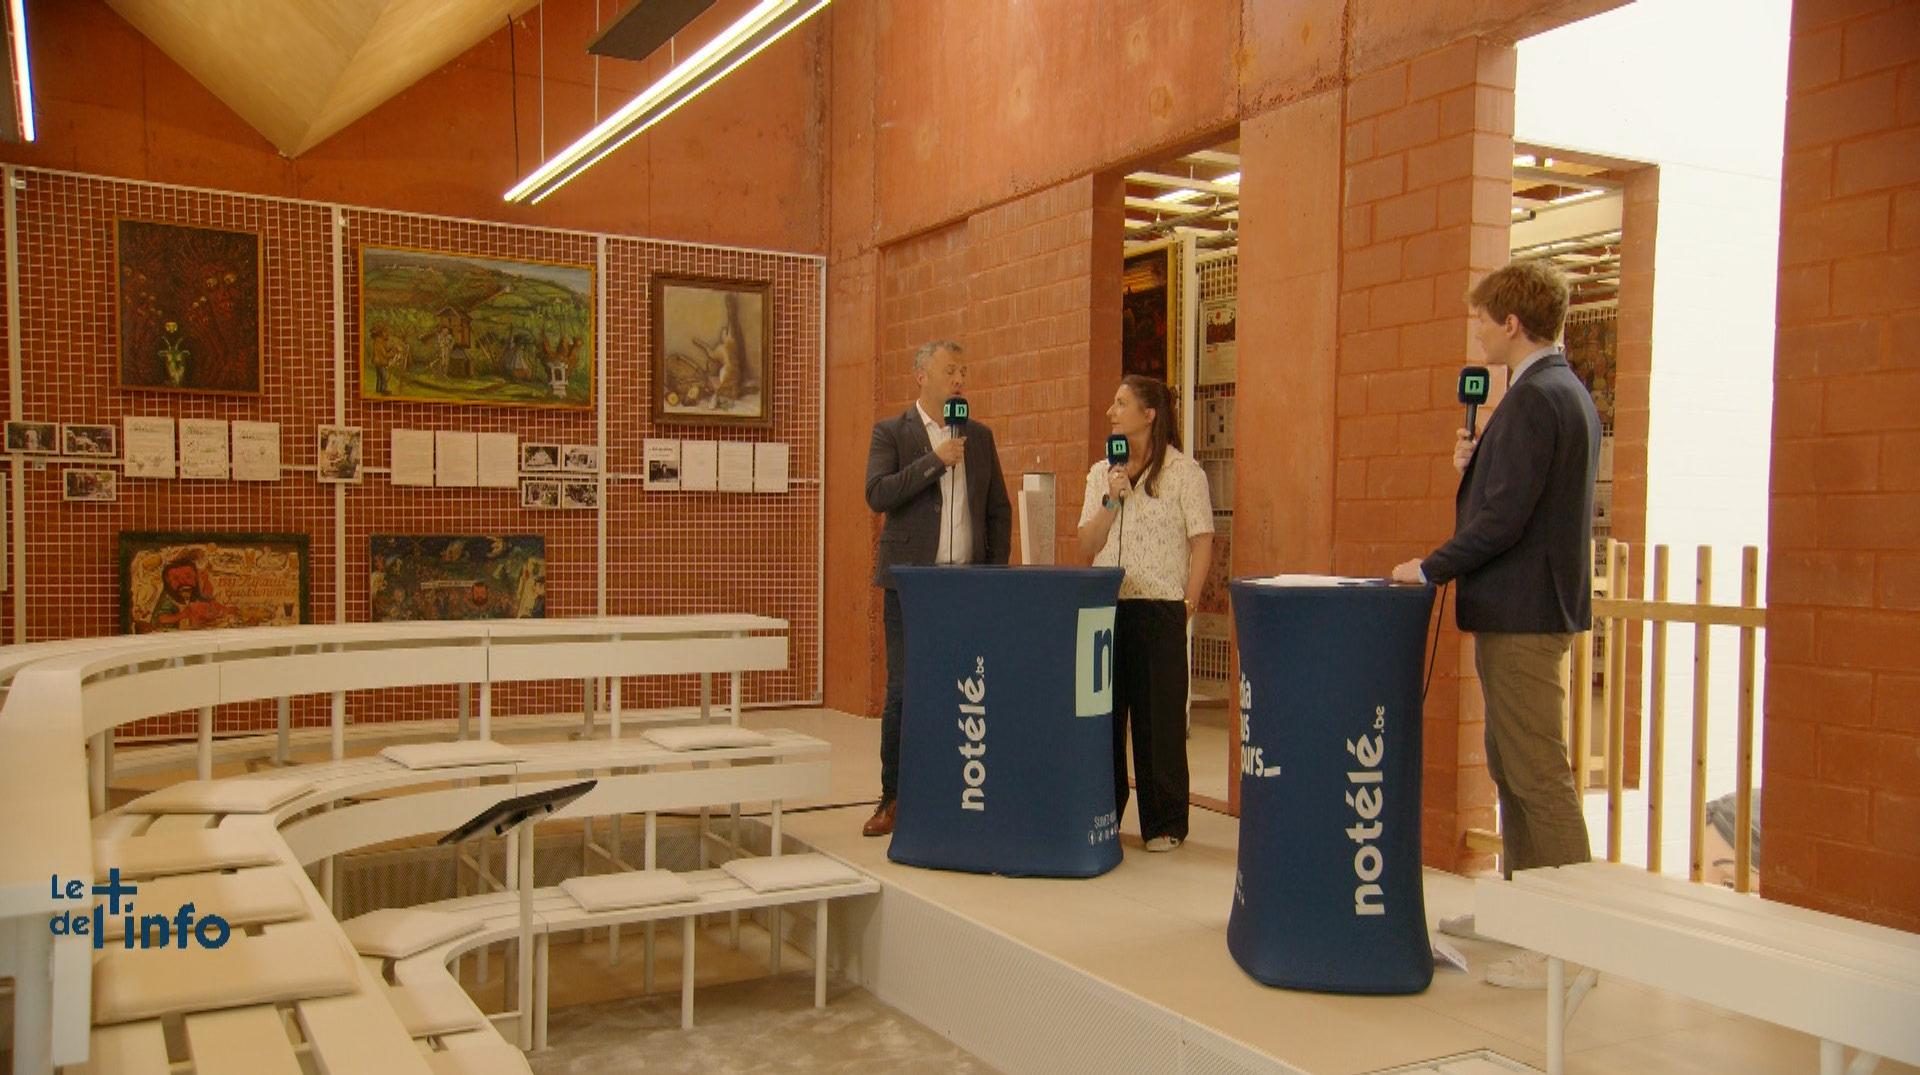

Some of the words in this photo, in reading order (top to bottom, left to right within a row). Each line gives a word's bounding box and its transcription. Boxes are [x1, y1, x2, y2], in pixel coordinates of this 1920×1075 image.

[1470, 380, 1480, 391] n
[1093, 628, 1112, 693] n
[1345, 705, 1386, 915] notélé.be
